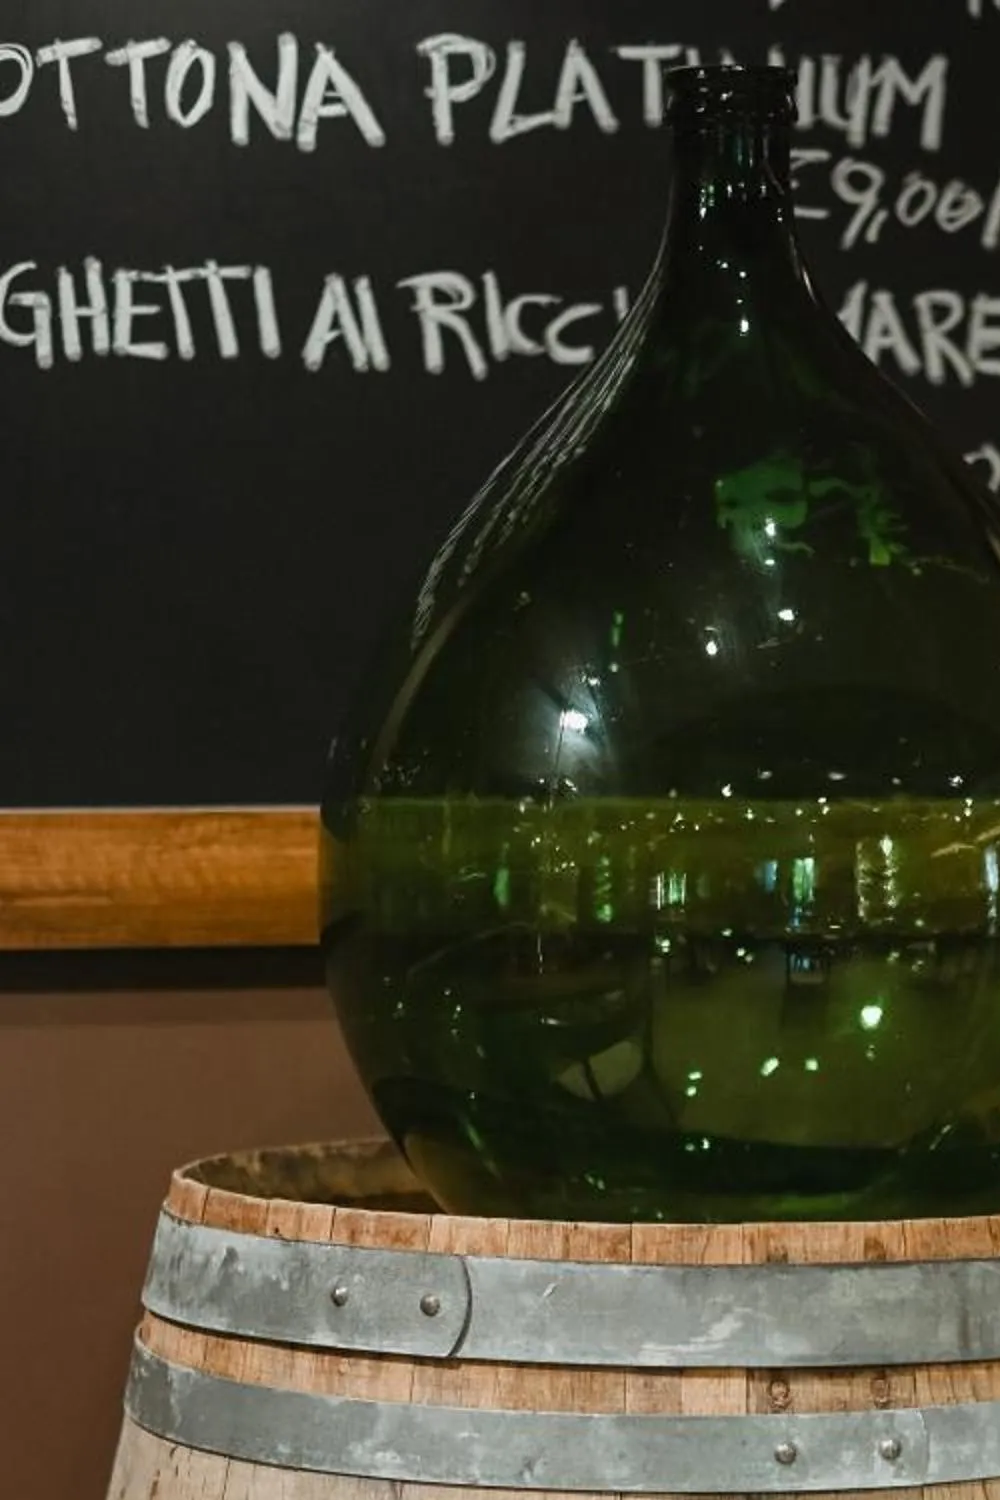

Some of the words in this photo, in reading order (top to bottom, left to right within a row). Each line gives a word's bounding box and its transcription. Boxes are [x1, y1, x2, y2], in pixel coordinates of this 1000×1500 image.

[416, 33, 949, 151] PLATIUM
[0, 255, 281, 370] GHETTI
[303, 272, 390, 372] AI
